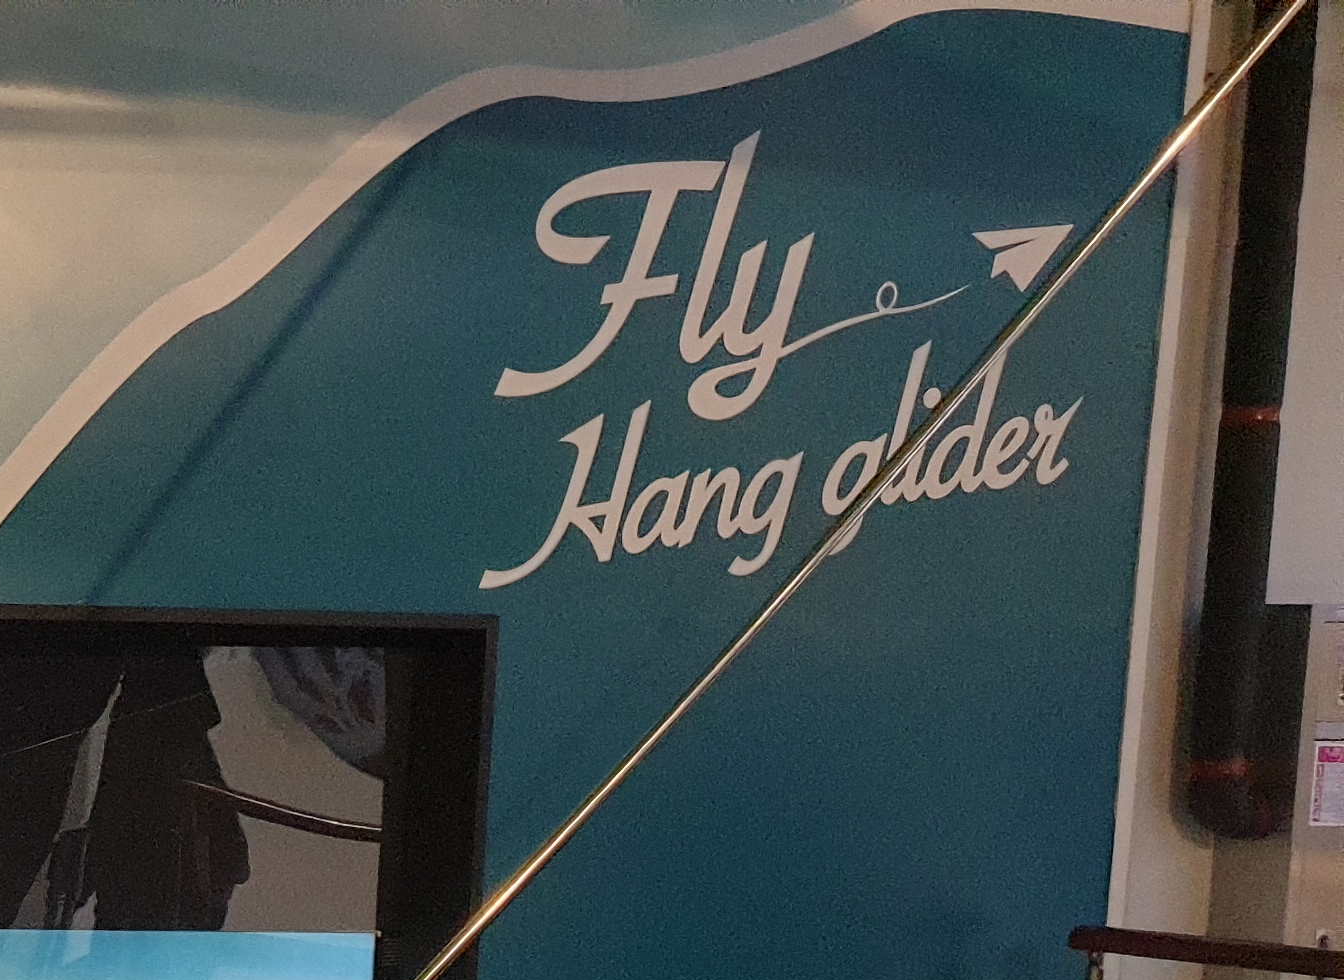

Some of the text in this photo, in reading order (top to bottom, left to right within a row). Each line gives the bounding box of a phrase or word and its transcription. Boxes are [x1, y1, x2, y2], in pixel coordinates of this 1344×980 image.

[493, 130, 815, 421] Fly
[478, 339, 1084, 589] Hang glider
